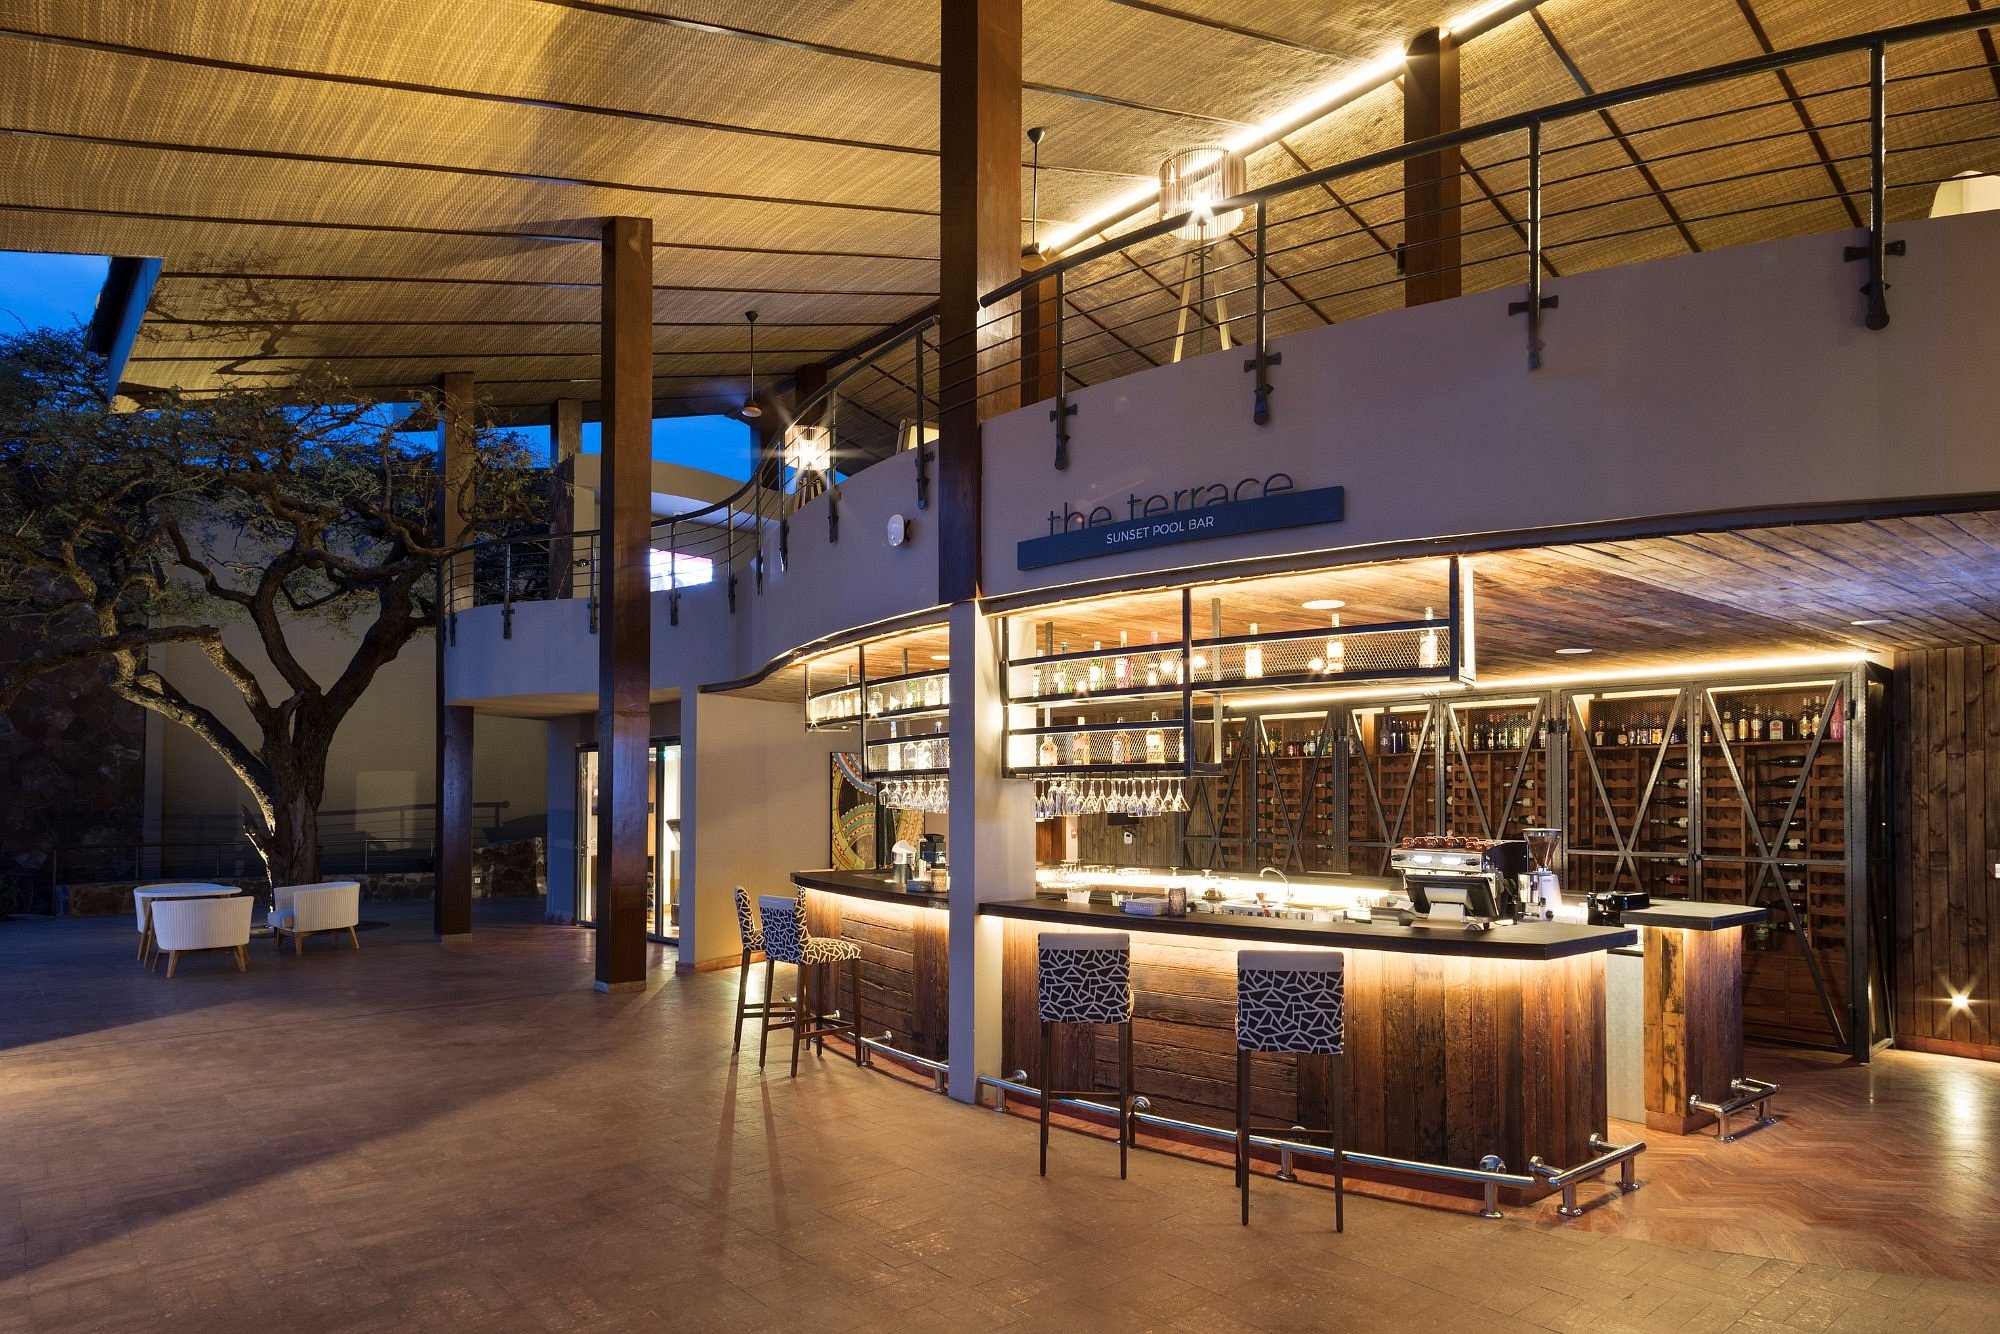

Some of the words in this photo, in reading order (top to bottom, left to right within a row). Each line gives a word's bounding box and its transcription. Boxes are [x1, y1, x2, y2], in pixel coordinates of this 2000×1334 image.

[1048, 502, 1112, 536] the
[1127, 472, 1294, 521] terrace
[1106, 526, 1150, 544] SUNSET
[1152, 521, 1185, 536] POOL
[1188, 516, 1214, 530] BAR
